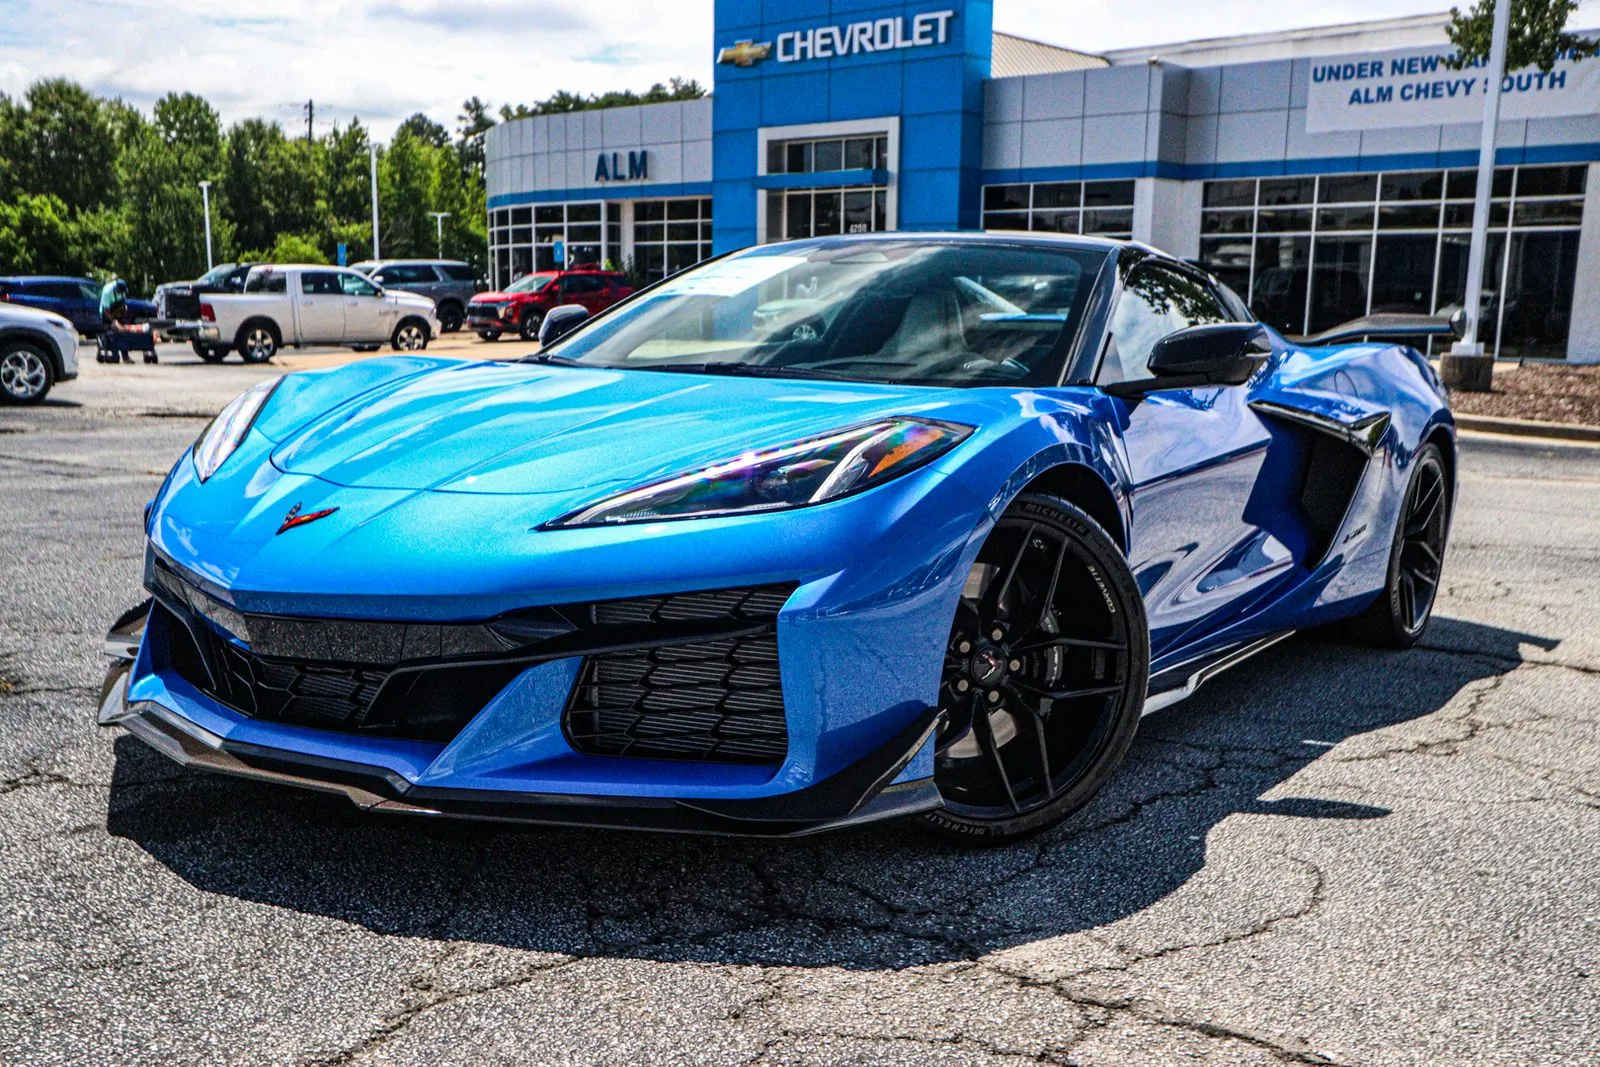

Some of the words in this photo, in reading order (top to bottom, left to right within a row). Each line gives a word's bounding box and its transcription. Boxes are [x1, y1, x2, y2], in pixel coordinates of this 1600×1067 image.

[777, 10, 953, 62] CHEVROLET
[1312, 60, 1384, 83] UNDER
[1390, 55, 1441, 77] NEW
[1348, 84, 1393, 105] ALM
[1401, 77, 1477, 101] CHEVY
[595, 150, 648, 182] ALM
[1024, 503, 1087, 534] MICHELIN
